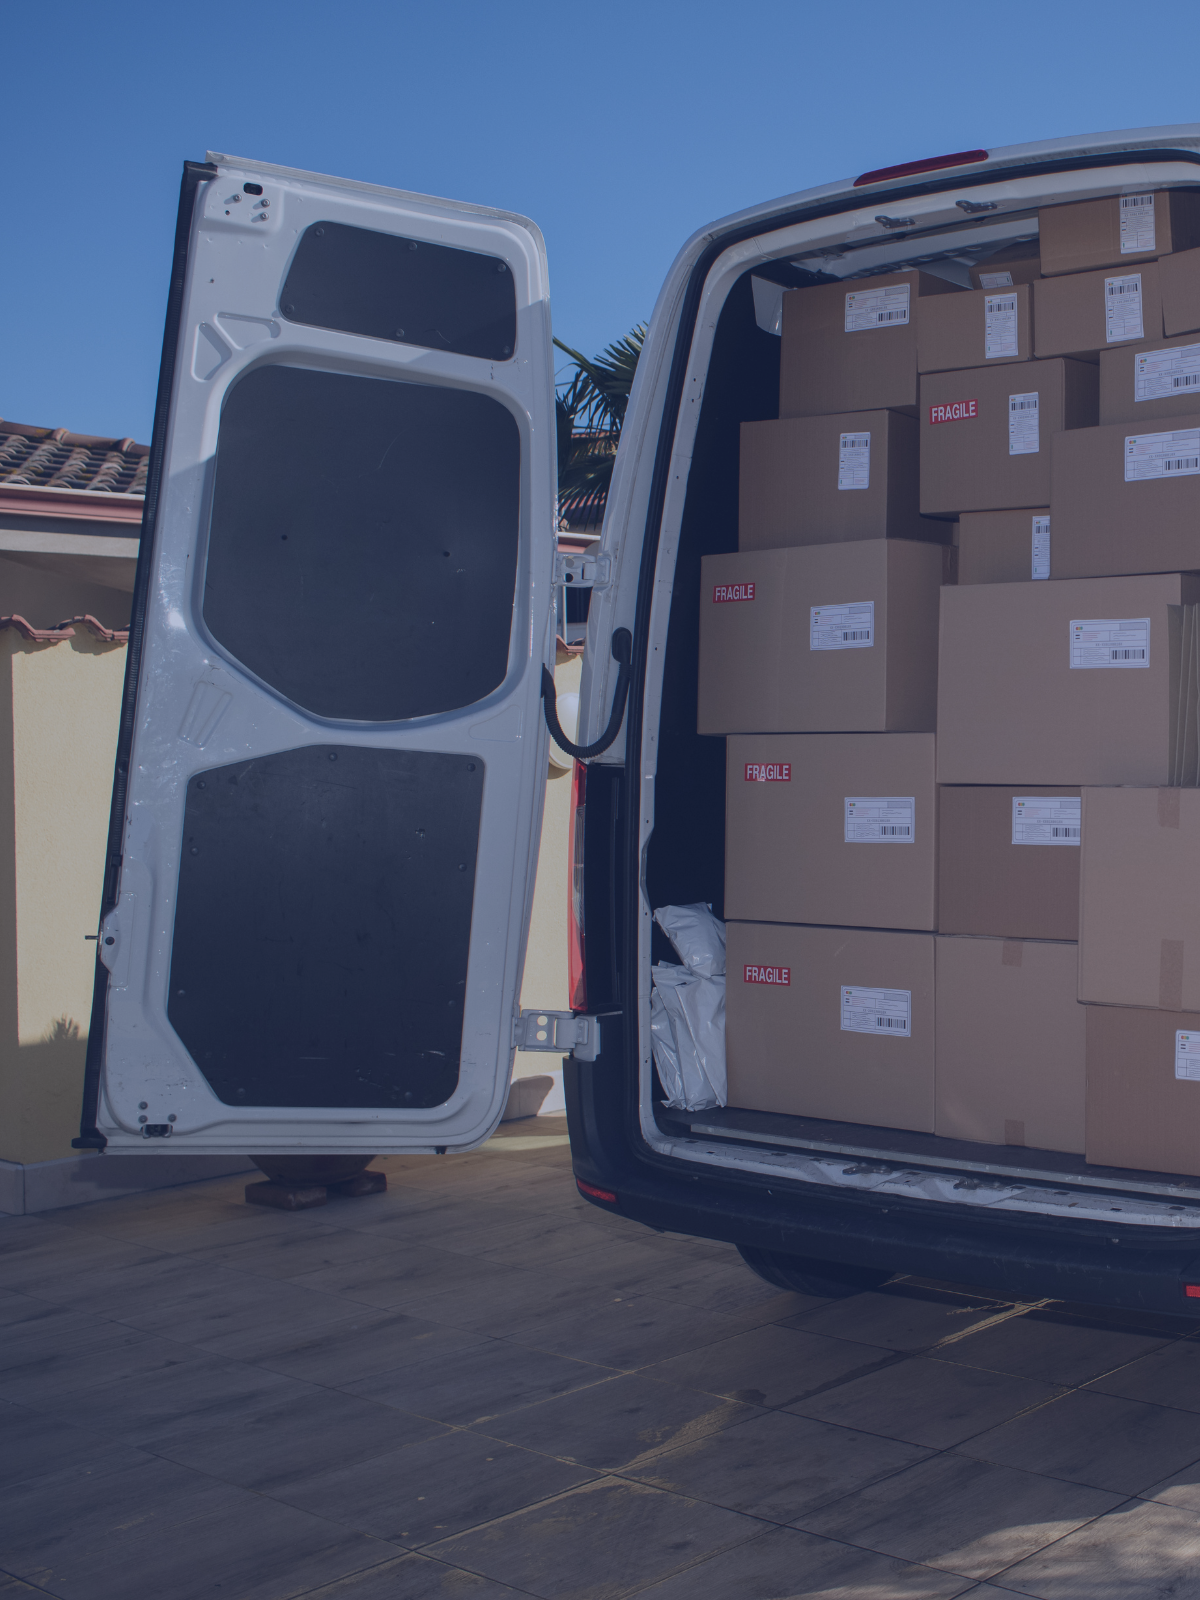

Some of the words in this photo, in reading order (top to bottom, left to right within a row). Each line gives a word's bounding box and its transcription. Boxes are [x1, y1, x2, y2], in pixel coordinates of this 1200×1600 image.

[932, 401, 976, 422] FRAGILE
[715, 584, 754, 601] FRAGILE
[746, 764, 789, 780] FRAGILE
[746, 966, 789, 984] FRAGILE
